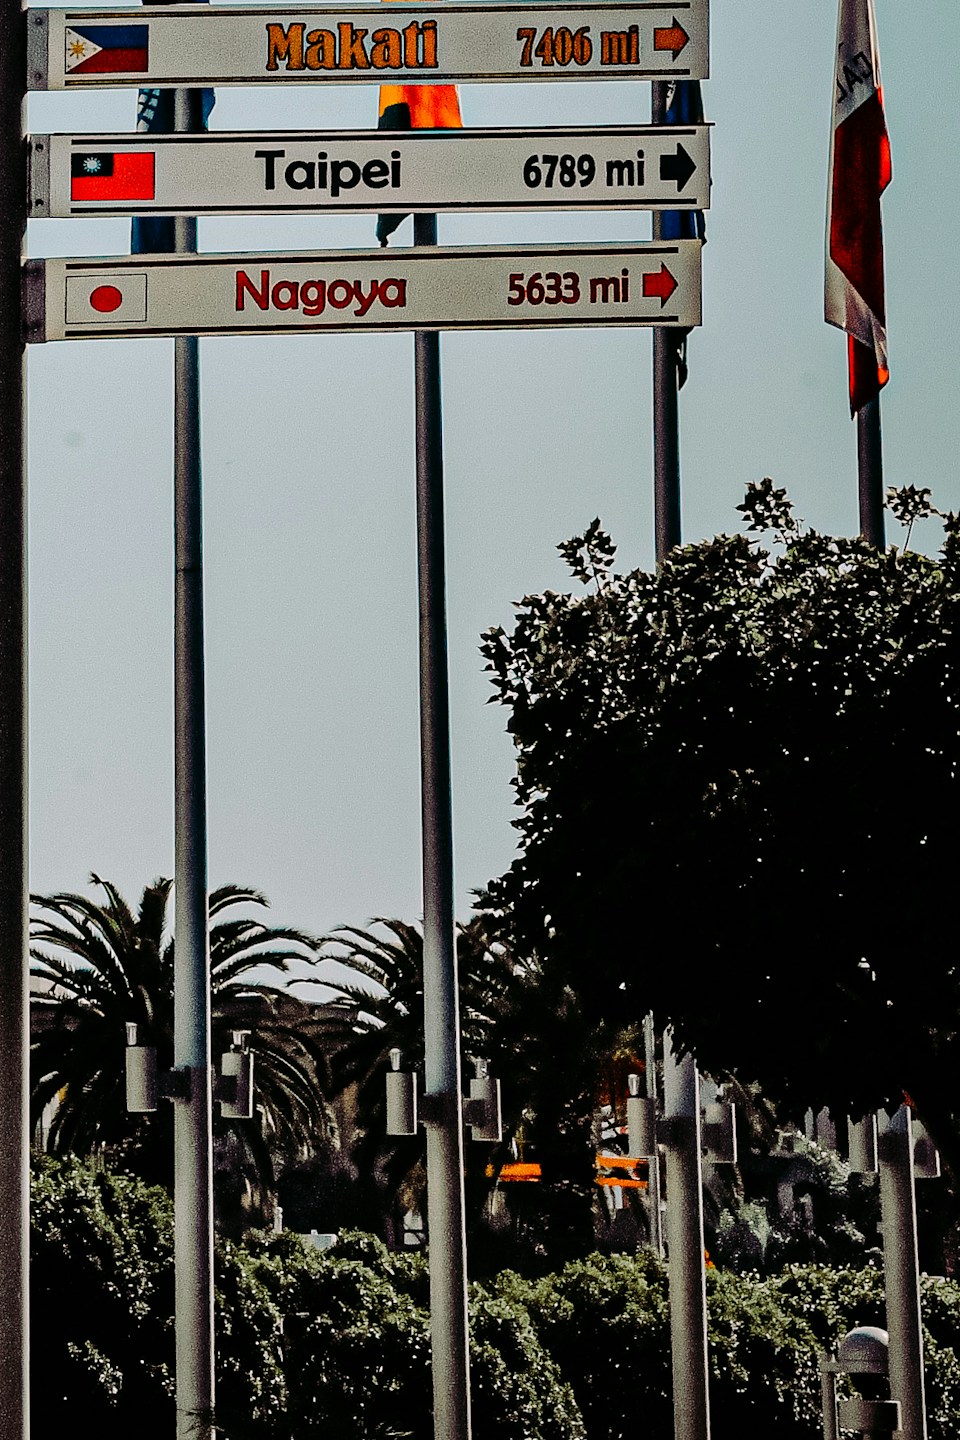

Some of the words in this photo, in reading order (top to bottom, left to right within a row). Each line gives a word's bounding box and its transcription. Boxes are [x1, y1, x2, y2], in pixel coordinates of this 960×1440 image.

[266, 21, 439, 72] Makati
[516, 26, 592, 66] 7406
[600, 23, 640, 65] mi
[255, 149, 401, 198] Taipei
[522, 153, 596, 190] 6789
[604, 149, 645, 188] mi
[235, 269, 408, 316] Nagoya
[507, 271, 580, 306] 5633
[588, 268, 628, 304] mi
